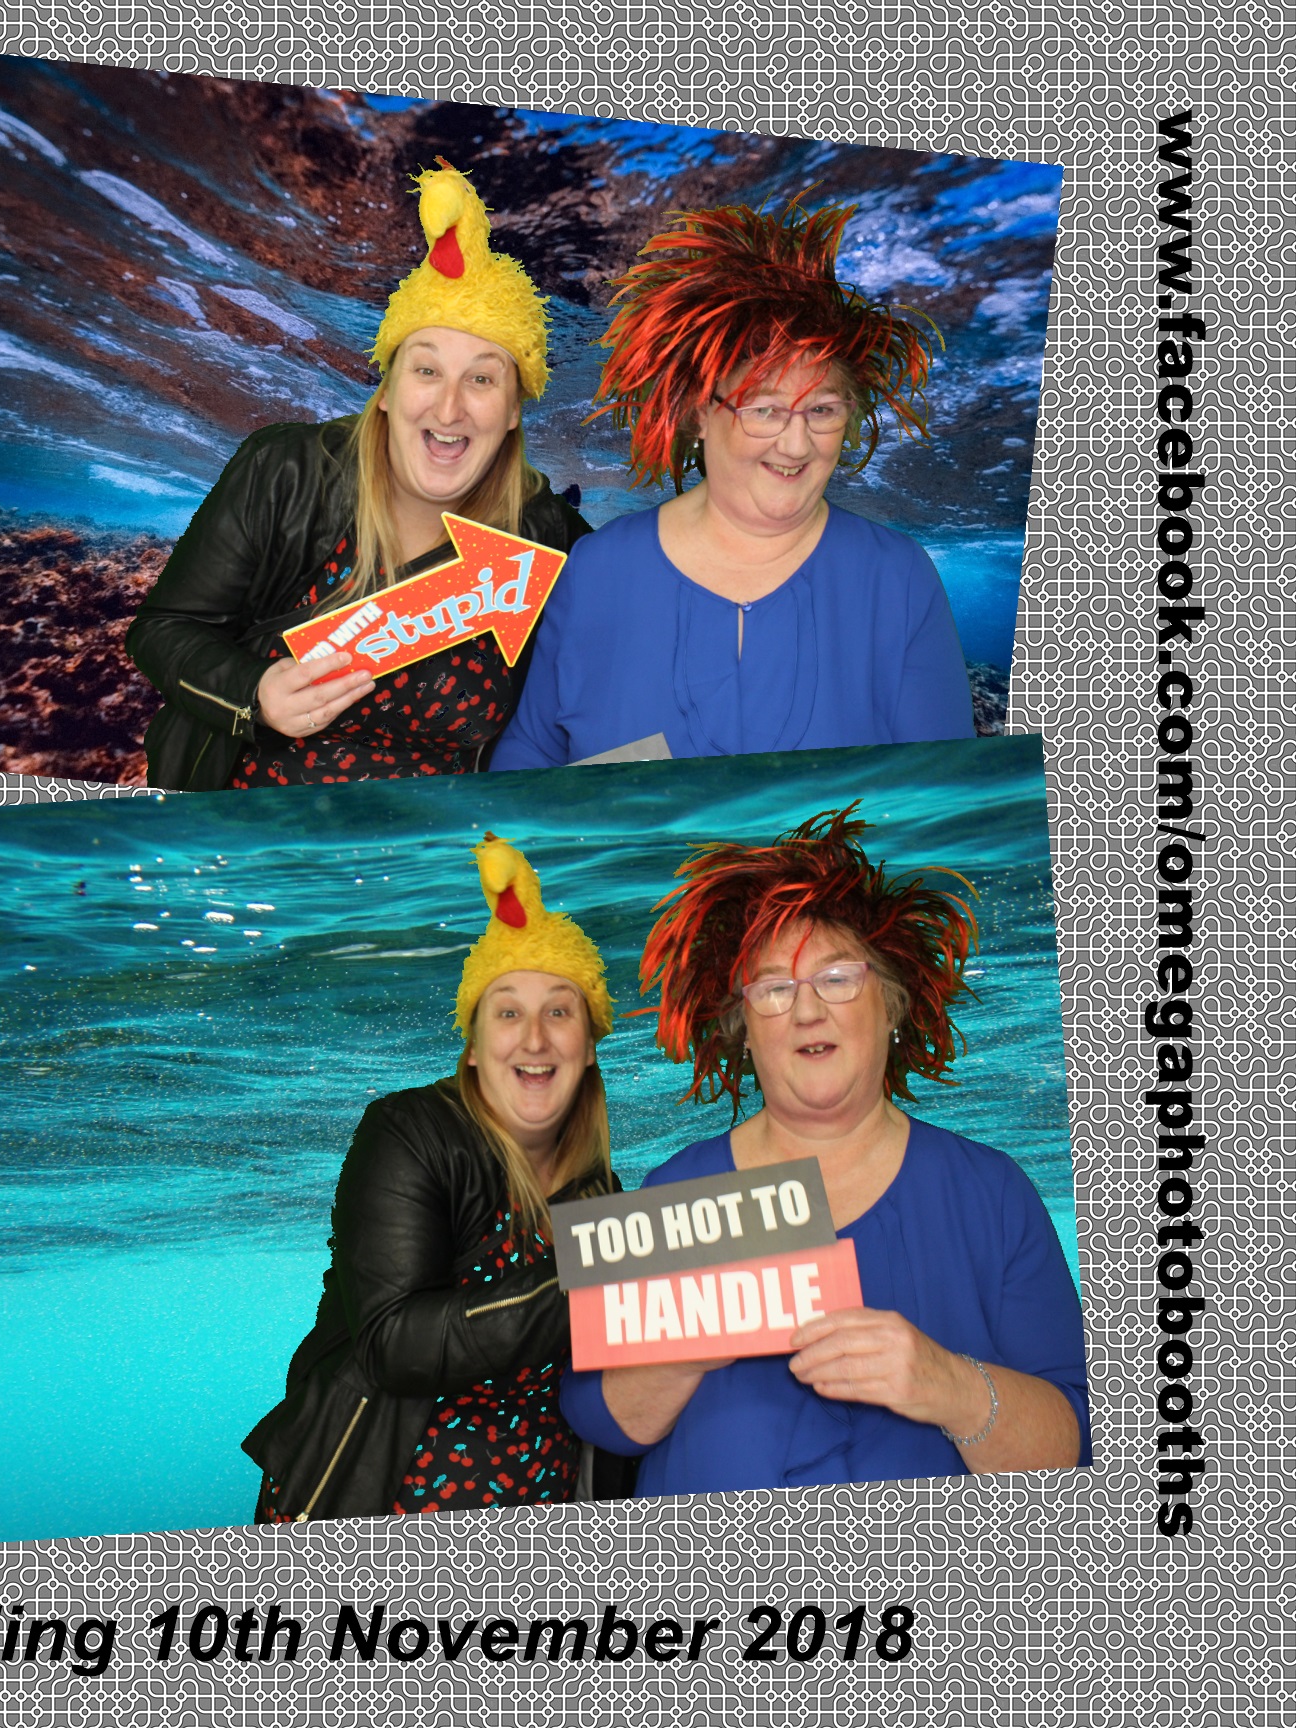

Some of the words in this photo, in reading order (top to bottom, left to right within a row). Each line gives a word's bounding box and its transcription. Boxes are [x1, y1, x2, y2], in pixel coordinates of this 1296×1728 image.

[327, 600, 384, 648] WITH
[355, 549, 536, 663] stupid
[571, 1211, 654, 1268] TOO
[660, 1191, 744, 1251] HOT
[750, 1179, 811, 1232] TO
[603, 1263, 826, 1346] HANDLE
